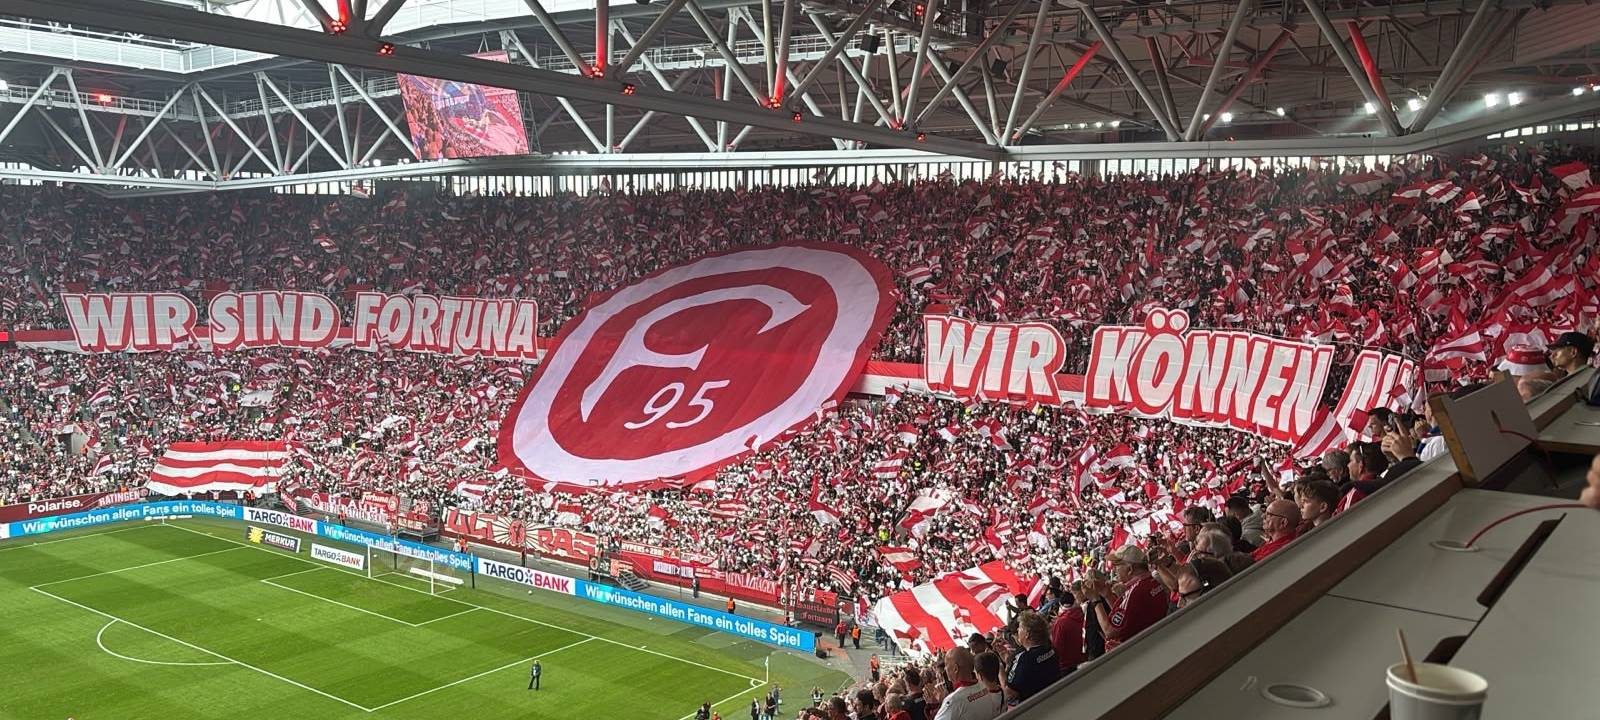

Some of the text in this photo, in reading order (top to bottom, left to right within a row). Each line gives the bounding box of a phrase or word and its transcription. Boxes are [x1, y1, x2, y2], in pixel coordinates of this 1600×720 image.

[61, 291, 538, 359] WIR SIND FORTUNA
[924, 315, 1067, 406] WIR
[1084, 308, 1335, 443] KÖNNEN
[623, 379, 730, 429] 95
[23, 503, 235, 534] Wir wünschen allen Fans ein tolles Spiel
[28, 499, 83, 515] Polarise.
[99, 490, 140, 507] RATINGEN
[264, 532, 296, 550] MERKUR
[324, 524, 337, 536] Wir
[339, 529, 374, 545] wünschen
[427, 549, 448, 564] tolles
[449, 553, 472, 569] Spiel
[585, 583, 801, 647] Wir wünschen allen Fans ein tolles Spiel
